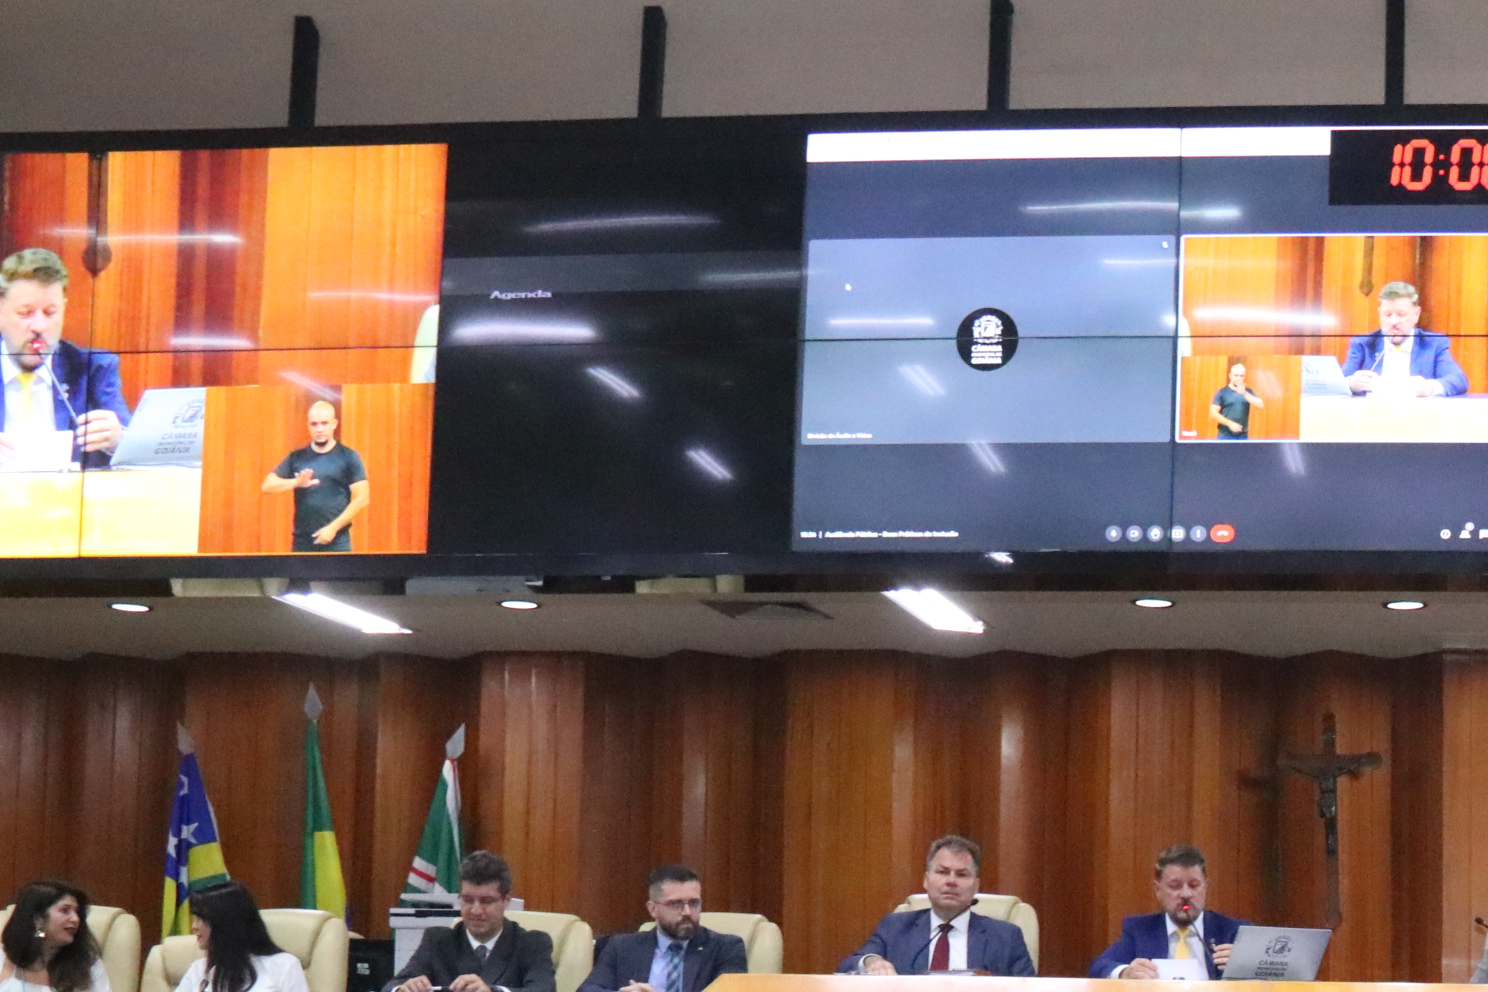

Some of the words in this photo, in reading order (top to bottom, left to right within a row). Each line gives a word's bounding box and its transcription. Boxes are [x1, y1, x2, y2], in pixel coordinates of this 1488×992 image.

[490, 290, 552, 300] Agenda
[161, 432, 198, 440] CÂMARA
[154, 446, 191, 454] GOIÂNIA
